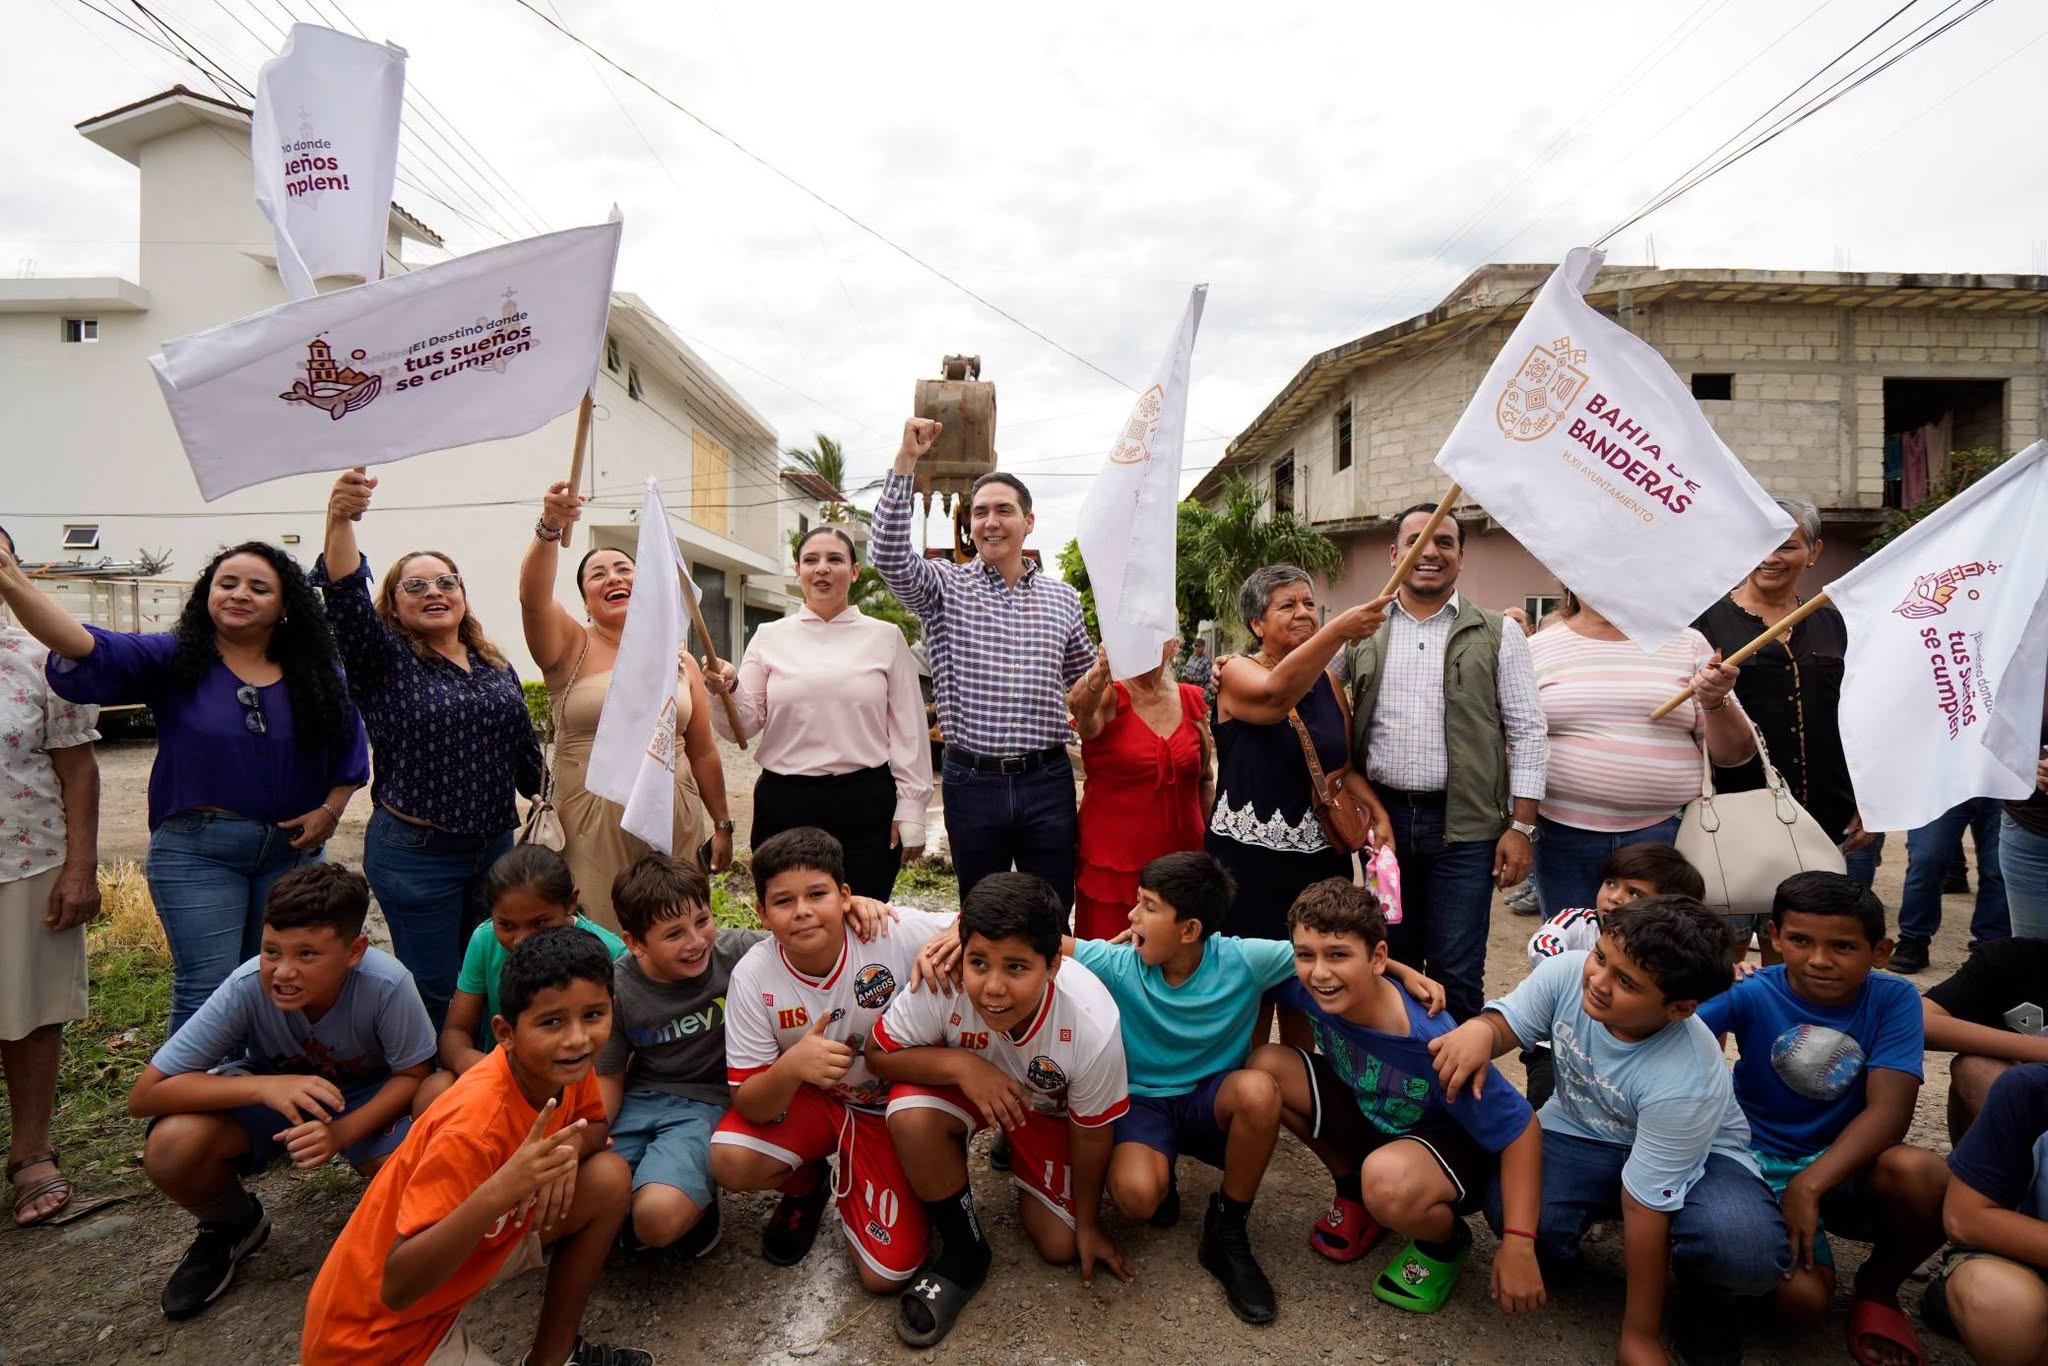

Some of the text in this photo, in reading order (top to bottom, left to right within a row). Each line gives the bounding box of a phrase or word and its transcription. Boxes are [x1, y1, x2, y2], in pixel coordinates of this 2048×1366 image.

[293, 138, 332, 151] donde
[404, 351, 445, 372] tus
[450, 326, 532, 360] sueños
[429, 325, 484, 347] Destino
[486, 312, 528, 330] donde
[396, 374, 424, 391] se
[430, 341, 531, 381] cumplen
[1567, 418, 1692, 514] BANDERAS
[1581, 466, 1654, 522] AYUNTAMIENTO
[1920, 627, 1960, 741] se cumplen
[1948, 630, 1977, 727] tus sueños
[858, 977, 895, 1004] AMIGOS
[778, 1007, 808, 1030] HS
[960, 1031, 989, 1049] HS
[1044, 1160, 1071, 1200] 11
[865, 1179, 899, 1228] 10
